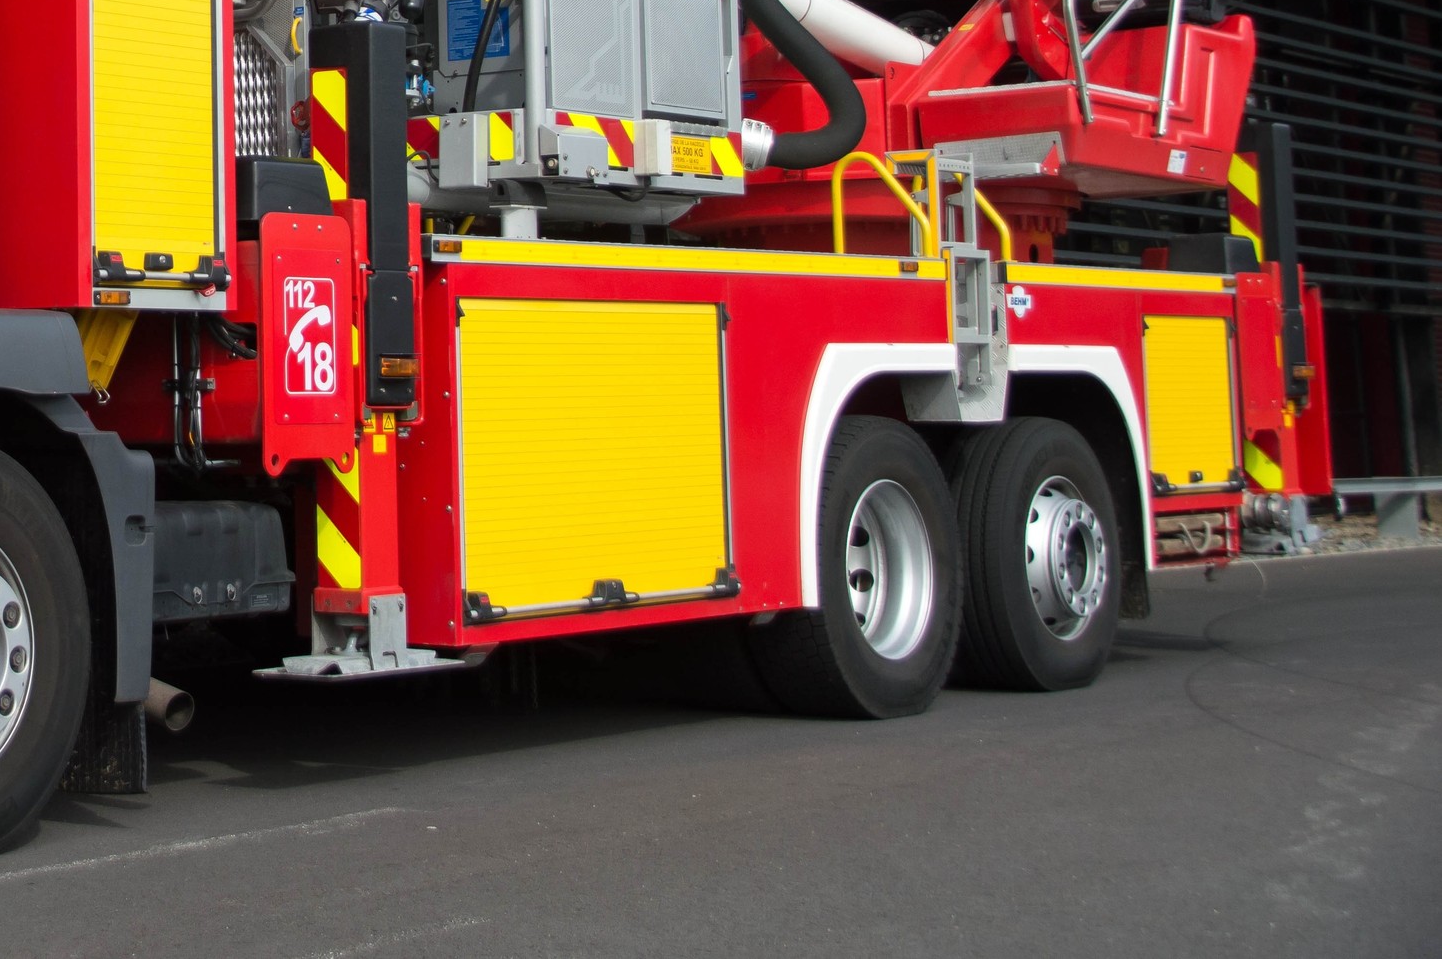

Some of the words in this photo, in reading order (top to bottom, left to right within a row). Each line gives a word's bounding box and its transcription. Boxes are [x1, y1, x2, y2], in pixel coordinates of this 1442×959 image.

[683, 146, 693, 156] 500
[694, 148, 704, 158] KG
[285, 280, 316, 308] 112
[297, 341, 334, 391] 18
